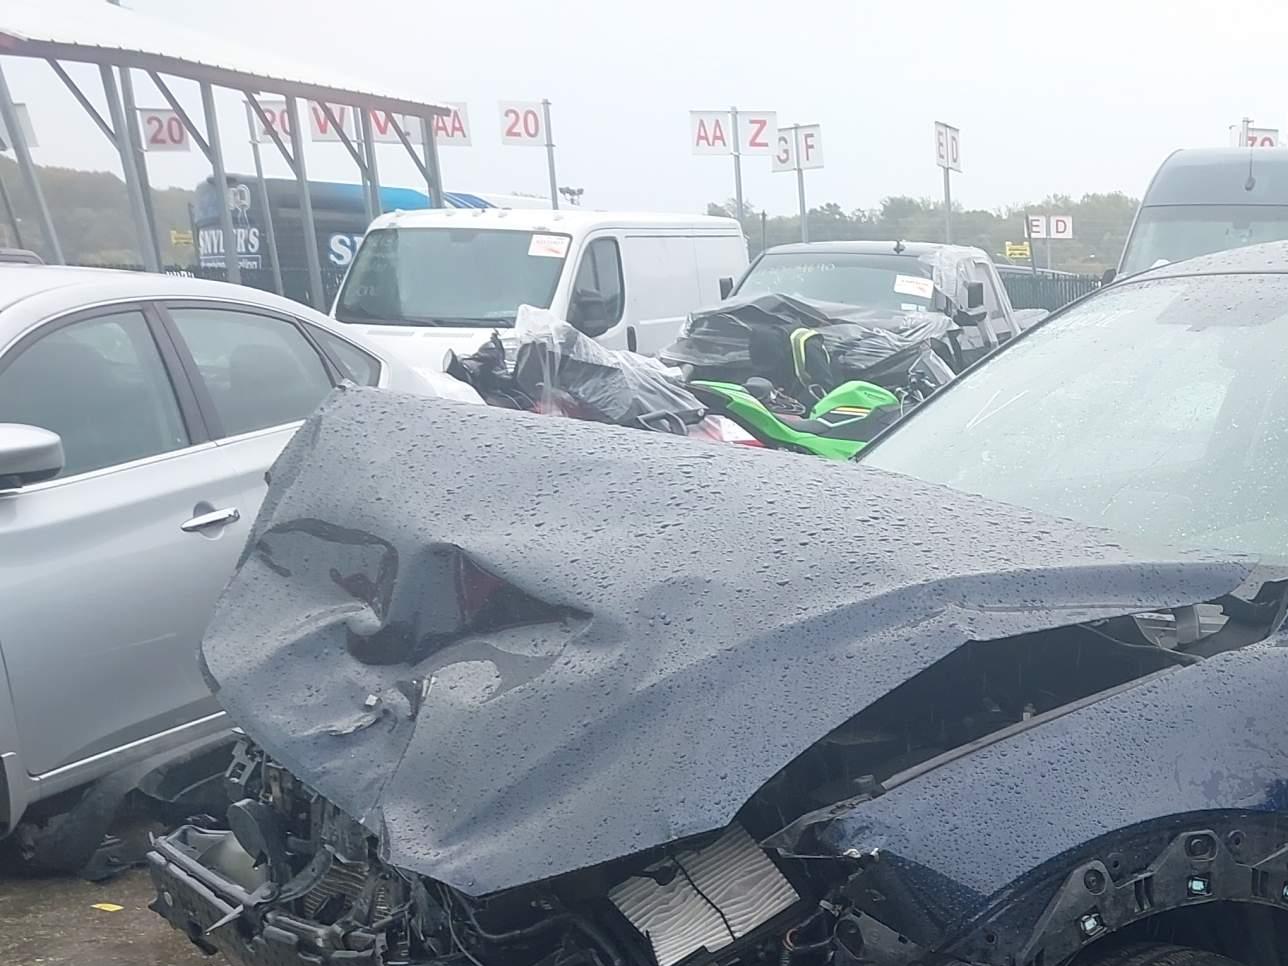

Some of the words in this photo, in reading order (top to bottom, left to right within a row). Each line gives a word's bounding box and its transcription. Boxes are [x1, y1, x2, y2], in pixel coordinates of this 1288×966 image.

[146, 115, 185, 145] 20
[433, 110, 467, 138] AA
[503, 108, 540, 138] 20
[695, 119, 727, 147] AA
[749, 119, 769, 147] Z
[776, 136, 790, 164] G
[804, 133, 815, 161] F
[937, 131, 946, 160] E
[951, 135, 958, 163] D
[1029, 218, 1041, 234] E
[1055, 219, 1067, 234] D
